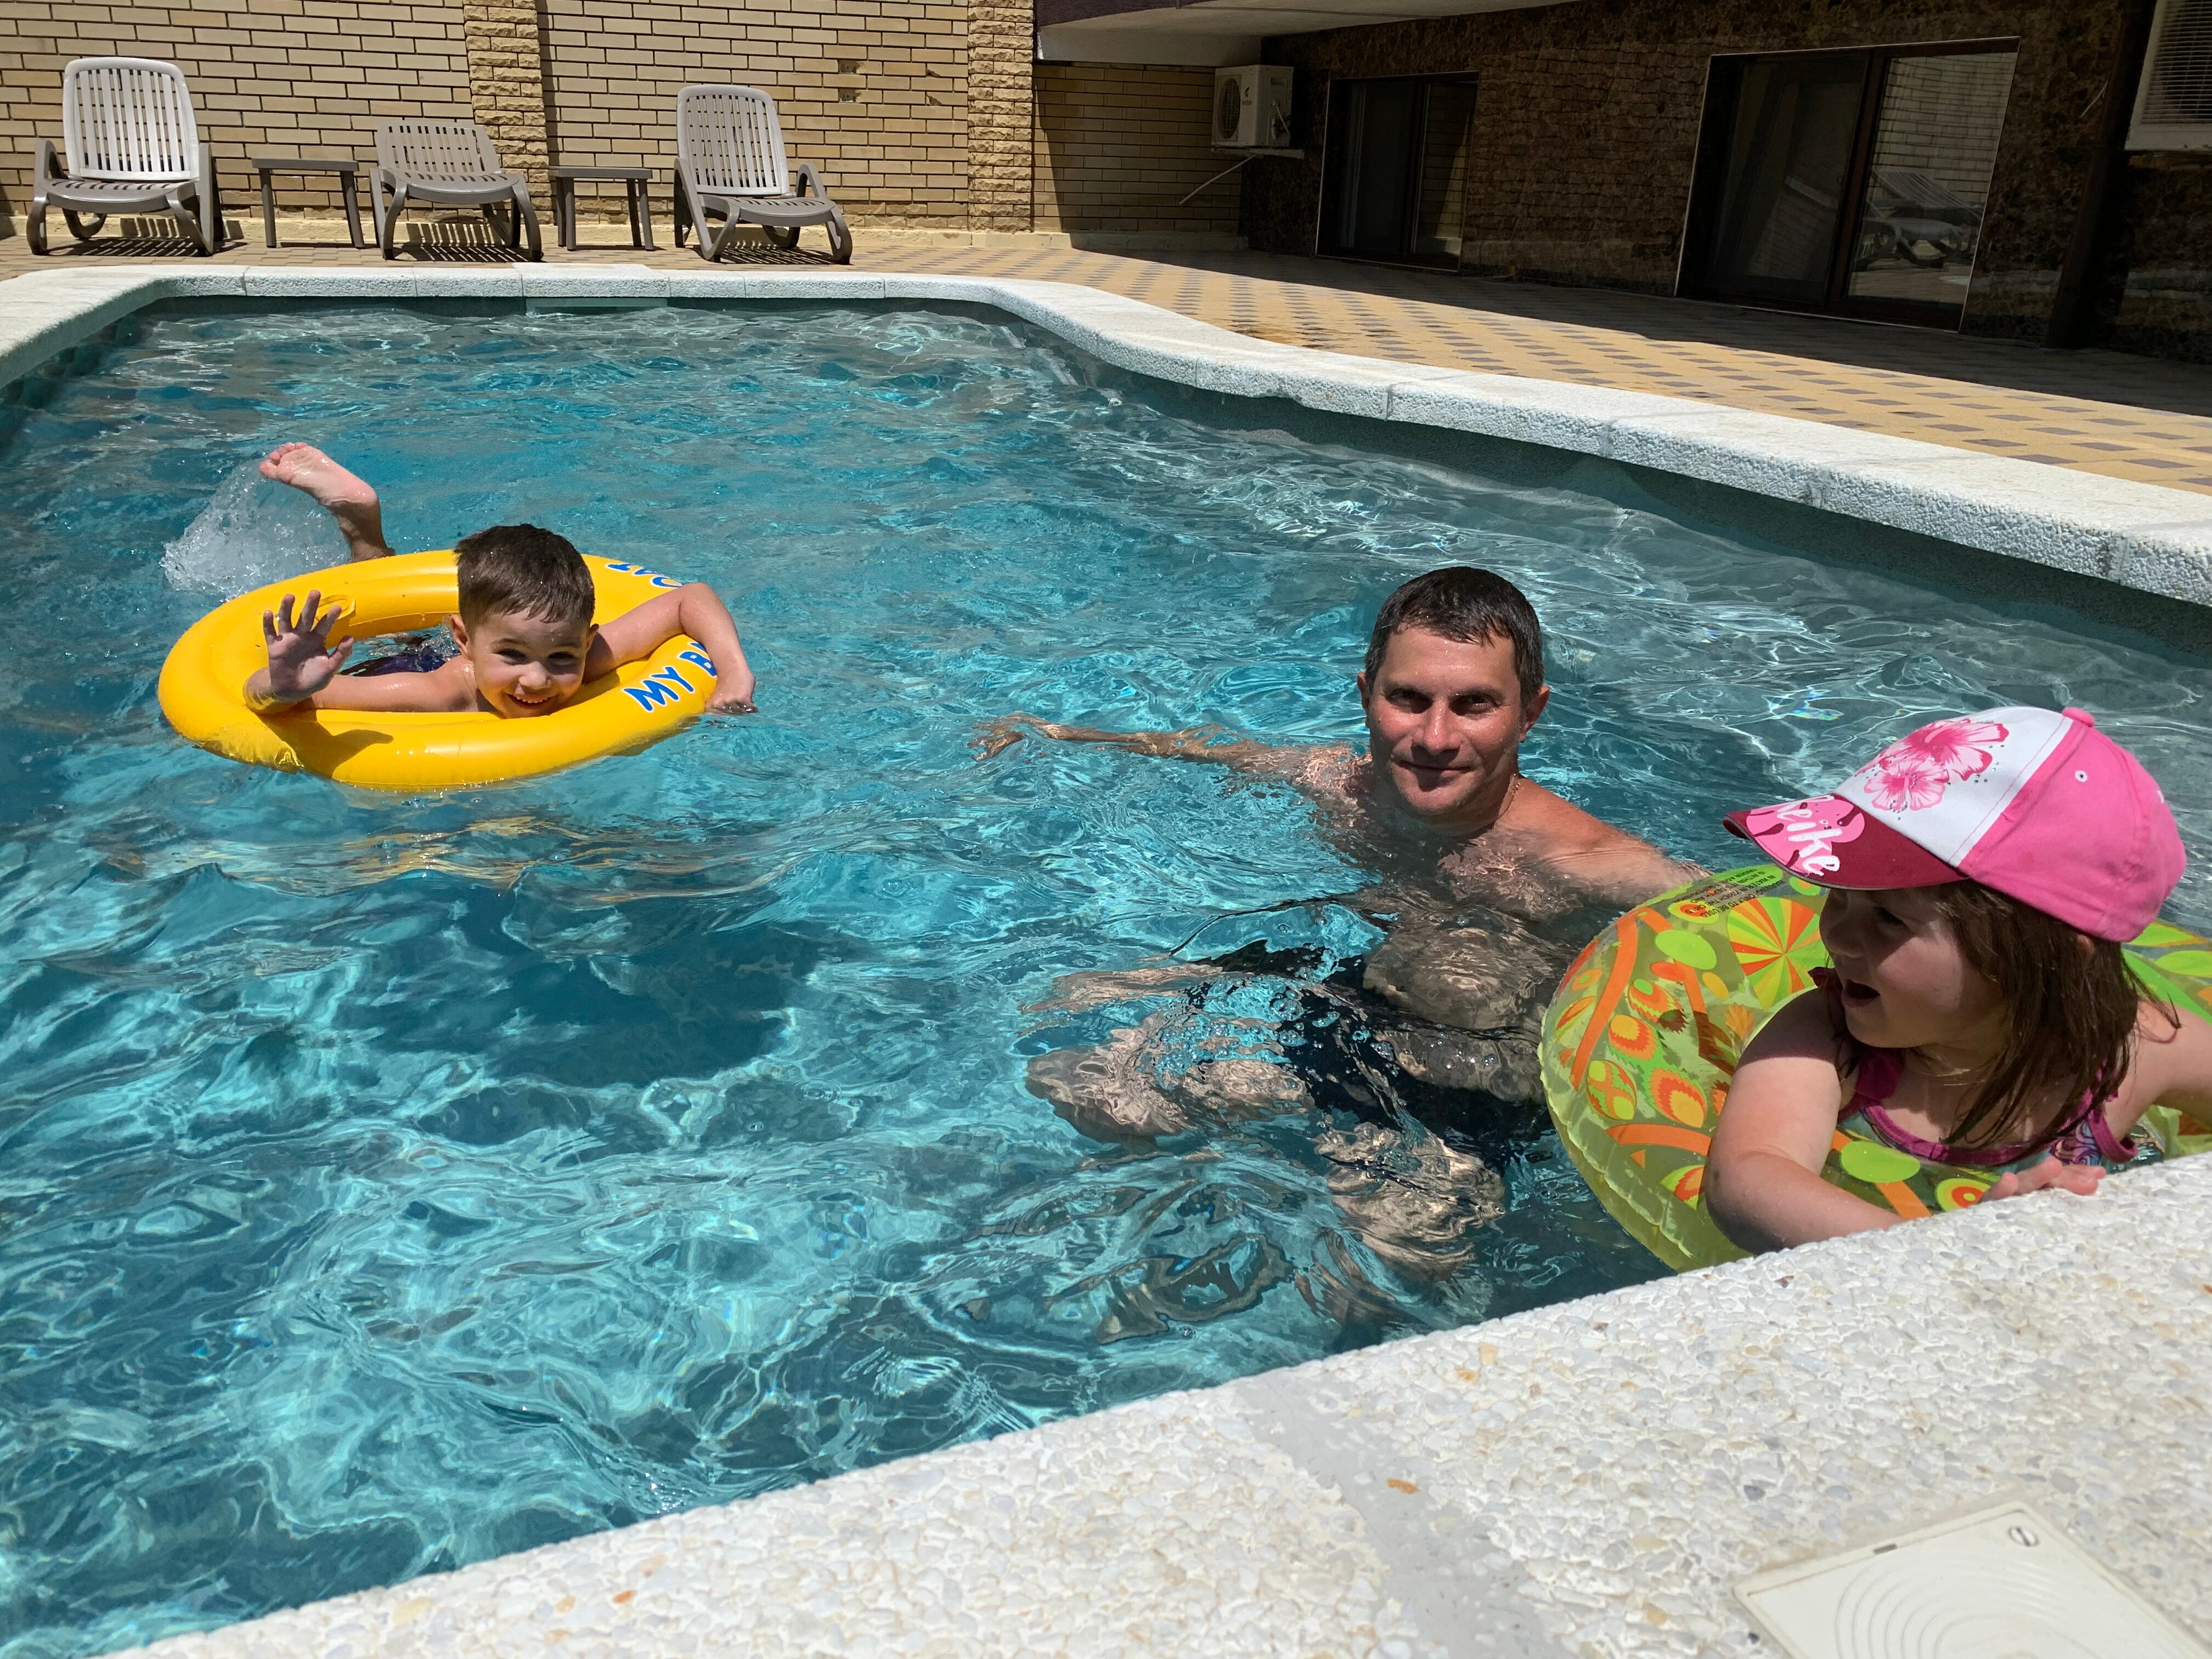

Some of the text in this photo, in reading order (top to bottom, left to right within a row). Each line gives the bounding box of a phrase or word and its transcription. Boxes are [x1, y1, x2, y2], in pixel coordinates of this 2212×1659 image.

[604, 562, 684, 589] OAT
[622, 665, 695, 713] MY
[1747, 877, 1770, 889] WATER
[1717, 890, 1742, 901] WHICH
[1739, 894, 1756, 904] ONLY
[1705, 899, 1719, 907] THE
[1685, 904, 1706, 914] CHILD
[1700, 909, 1720, 918] USED
